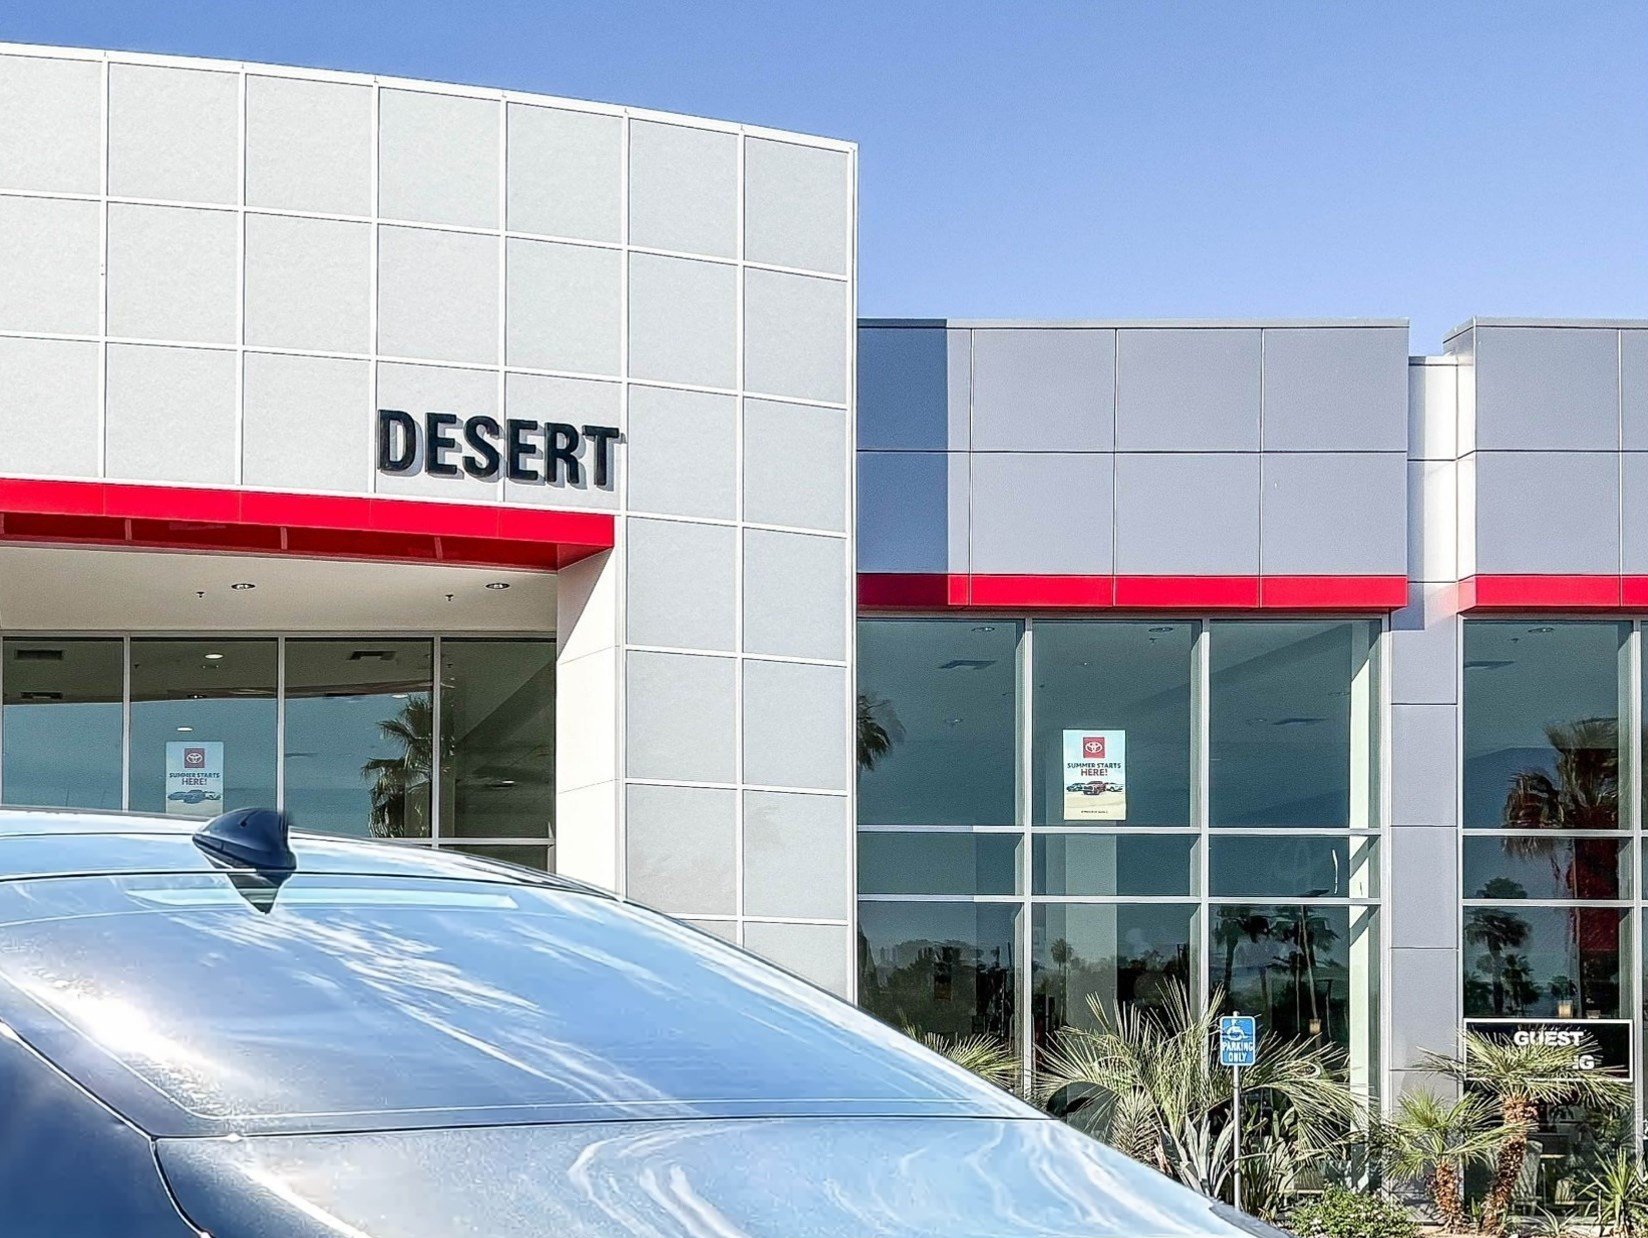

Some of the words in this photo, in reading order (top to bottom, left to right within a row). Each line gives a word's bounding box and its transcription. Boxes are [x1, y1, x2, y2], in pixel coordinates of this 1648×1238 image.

[377, 409, 620, 487] DESERT
[1081, 769, 1108, 777] HERE!
[1513, 1031, 1585, 1047] GUEST
[1222, 1041, 1254, 1052] PARKING
[1228, 1052, 1248, 1062] ONLY
